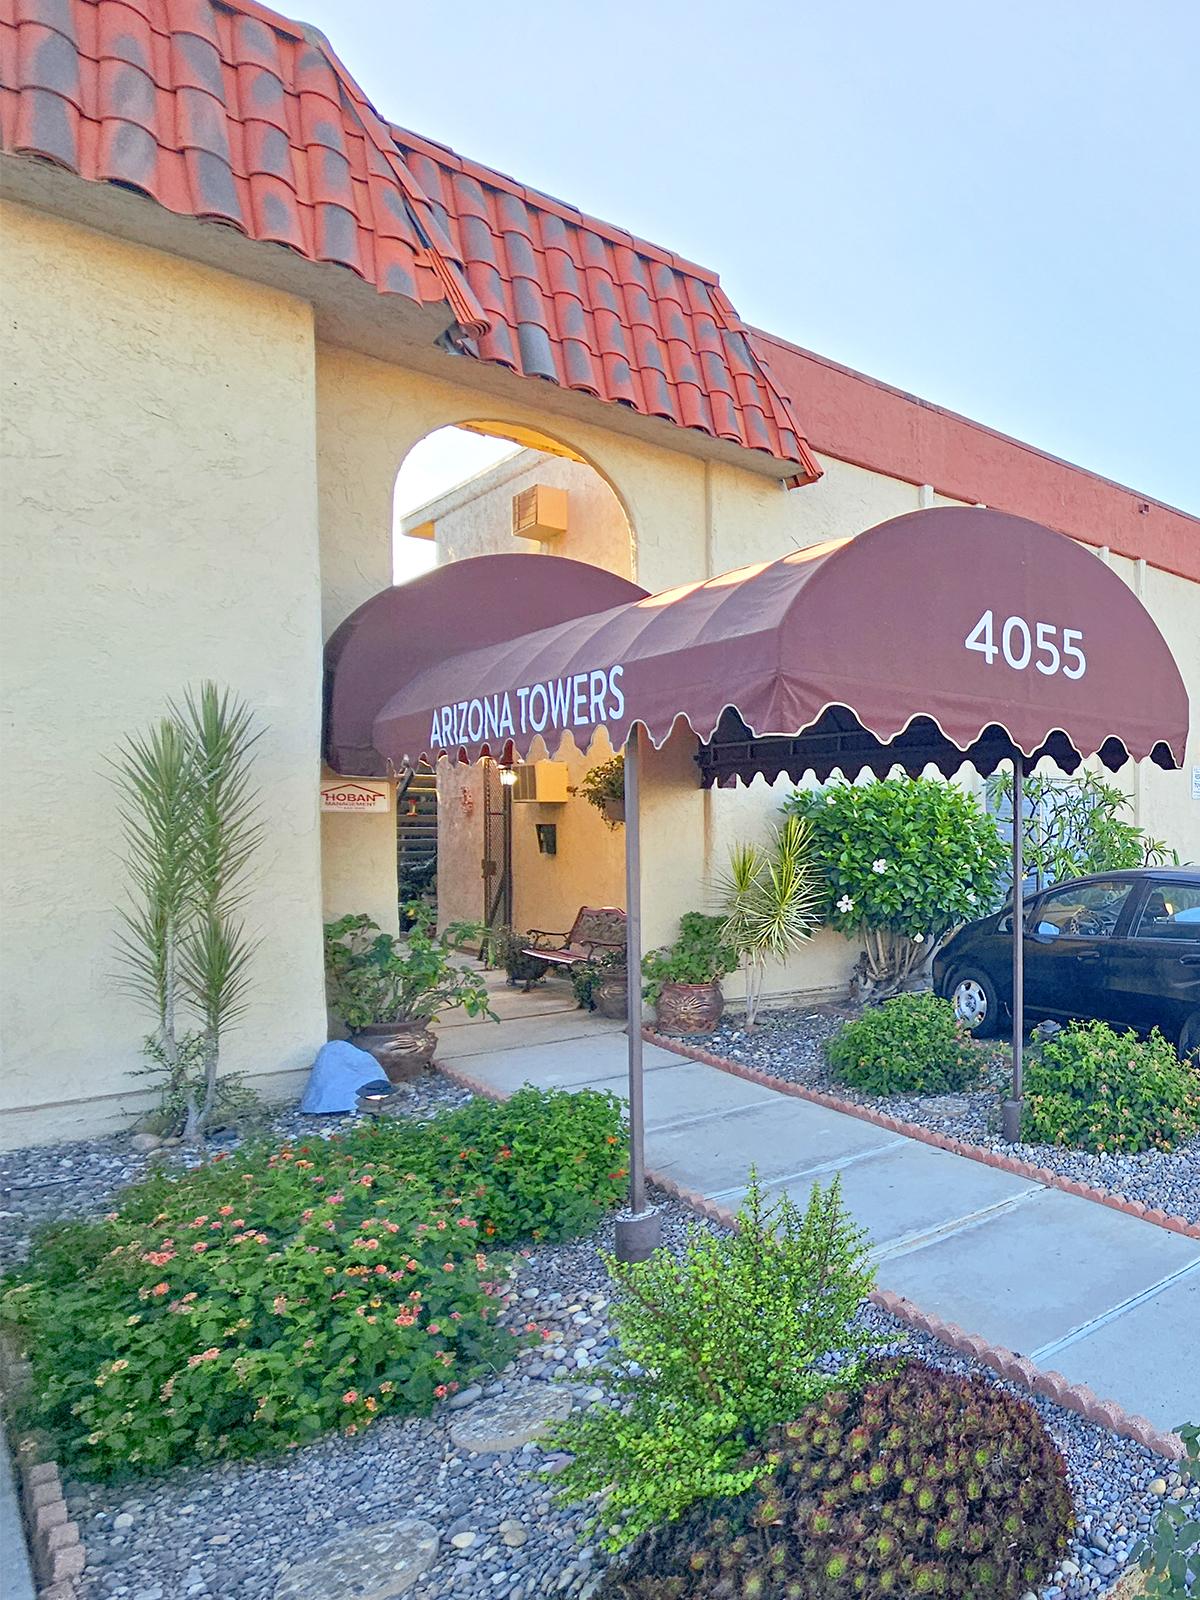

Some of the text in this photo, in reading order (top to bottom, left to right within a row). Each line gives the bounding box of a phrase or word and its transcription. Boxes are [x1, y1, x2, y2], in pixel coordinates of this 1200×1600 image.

[965, 609, 1086, 680] 4055
[430, 664, 625, 749] ARIZONA TOWERS
[324, 793, 376, 802] HOBAN
